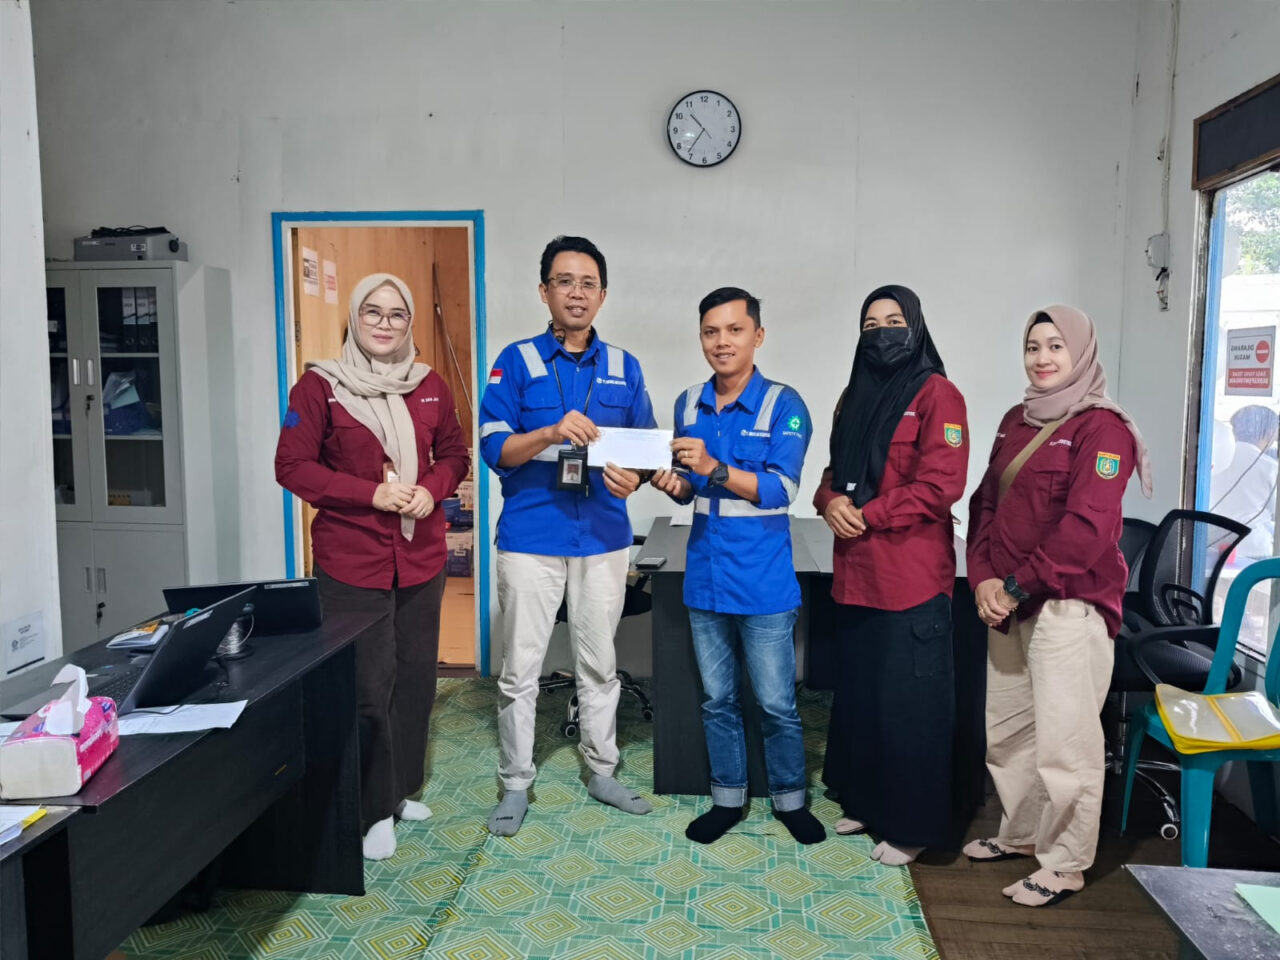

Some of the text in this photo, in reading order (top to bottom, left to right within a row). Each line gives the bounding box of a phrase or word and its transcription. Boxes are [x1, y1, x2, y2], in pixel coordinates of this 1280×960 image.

[700, 95, 709, 103] 12
[685, 100, 693, 108] 11
[675, 112, 683, 120] 10
[726, 110, 732, 118] 2
[730, 125, 736, 133] 3
[676, 142, 681, 150] 8
[702, 156, 707, 164] 6
